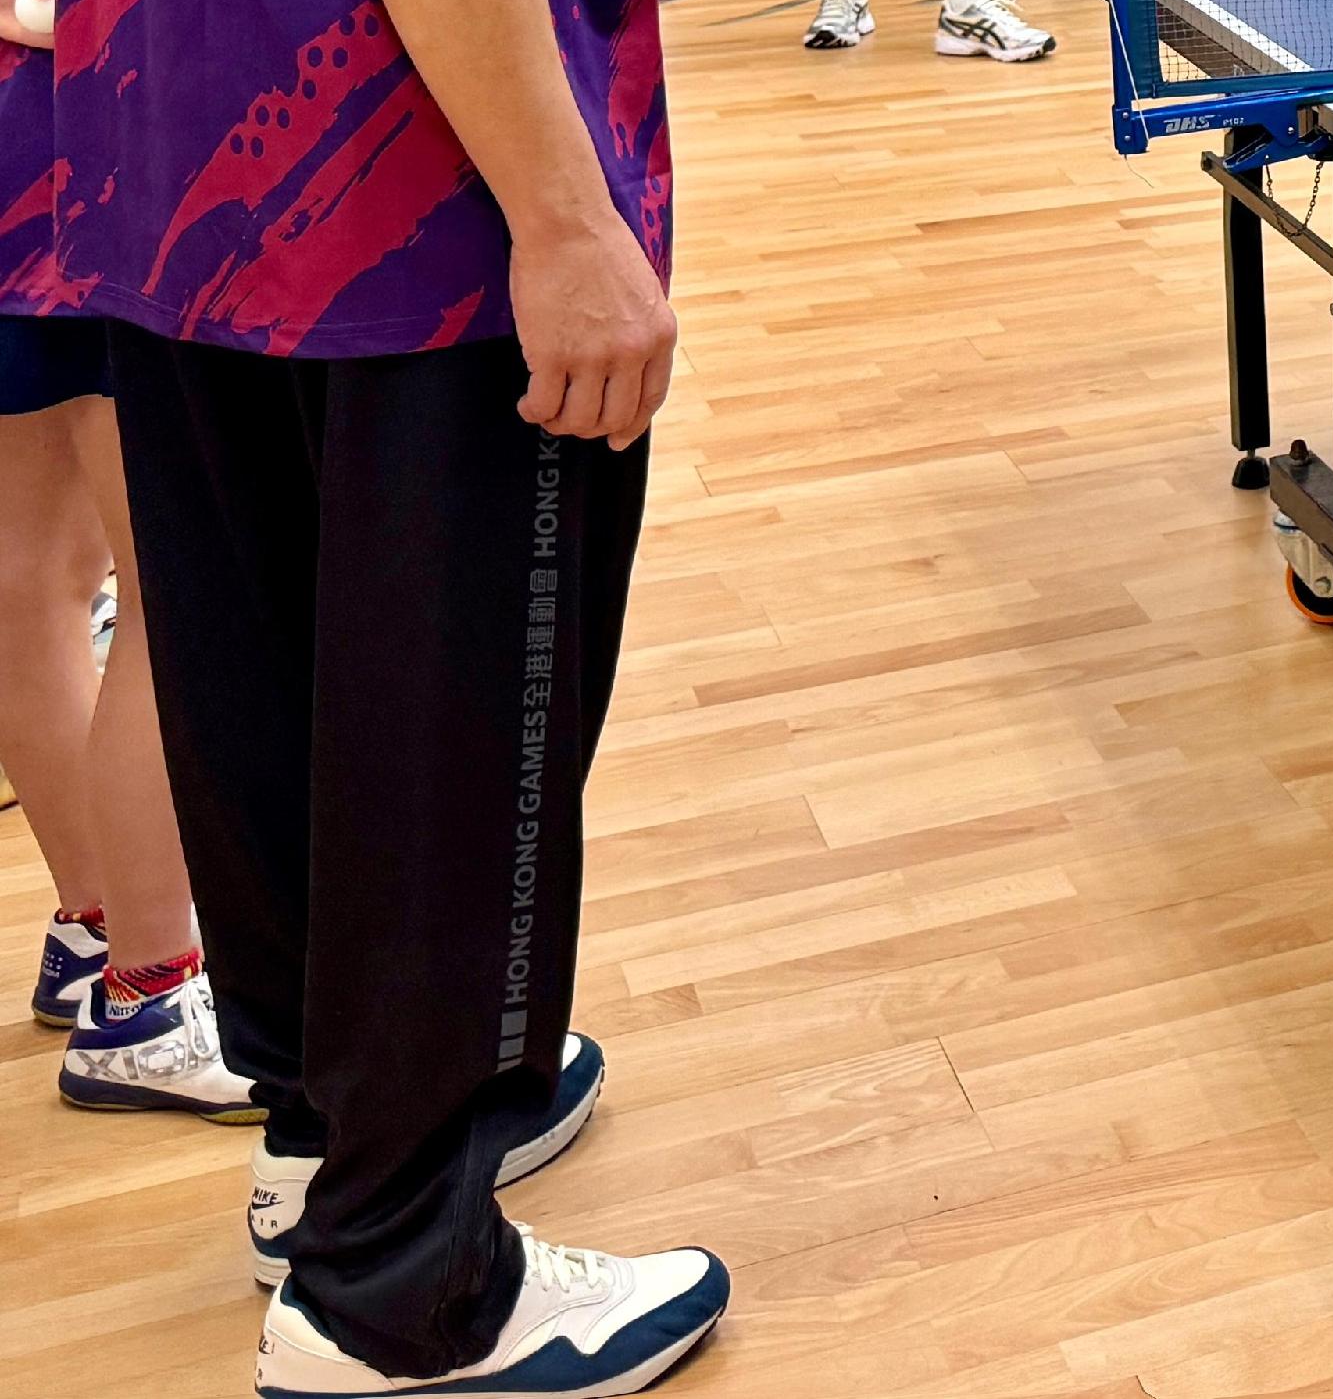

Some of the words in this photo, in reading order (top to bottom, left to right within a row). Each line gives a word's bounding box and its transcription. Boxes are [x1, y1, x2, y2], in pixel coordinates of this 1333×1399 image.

[533, 467, 560, 558] HONG
[518, 710, 547, 815] GAMES
[512, 820, 540, 909] KONG
[504, 913, 534, 1005] HONG
[252, 1186, 279, 1204] NIKE
